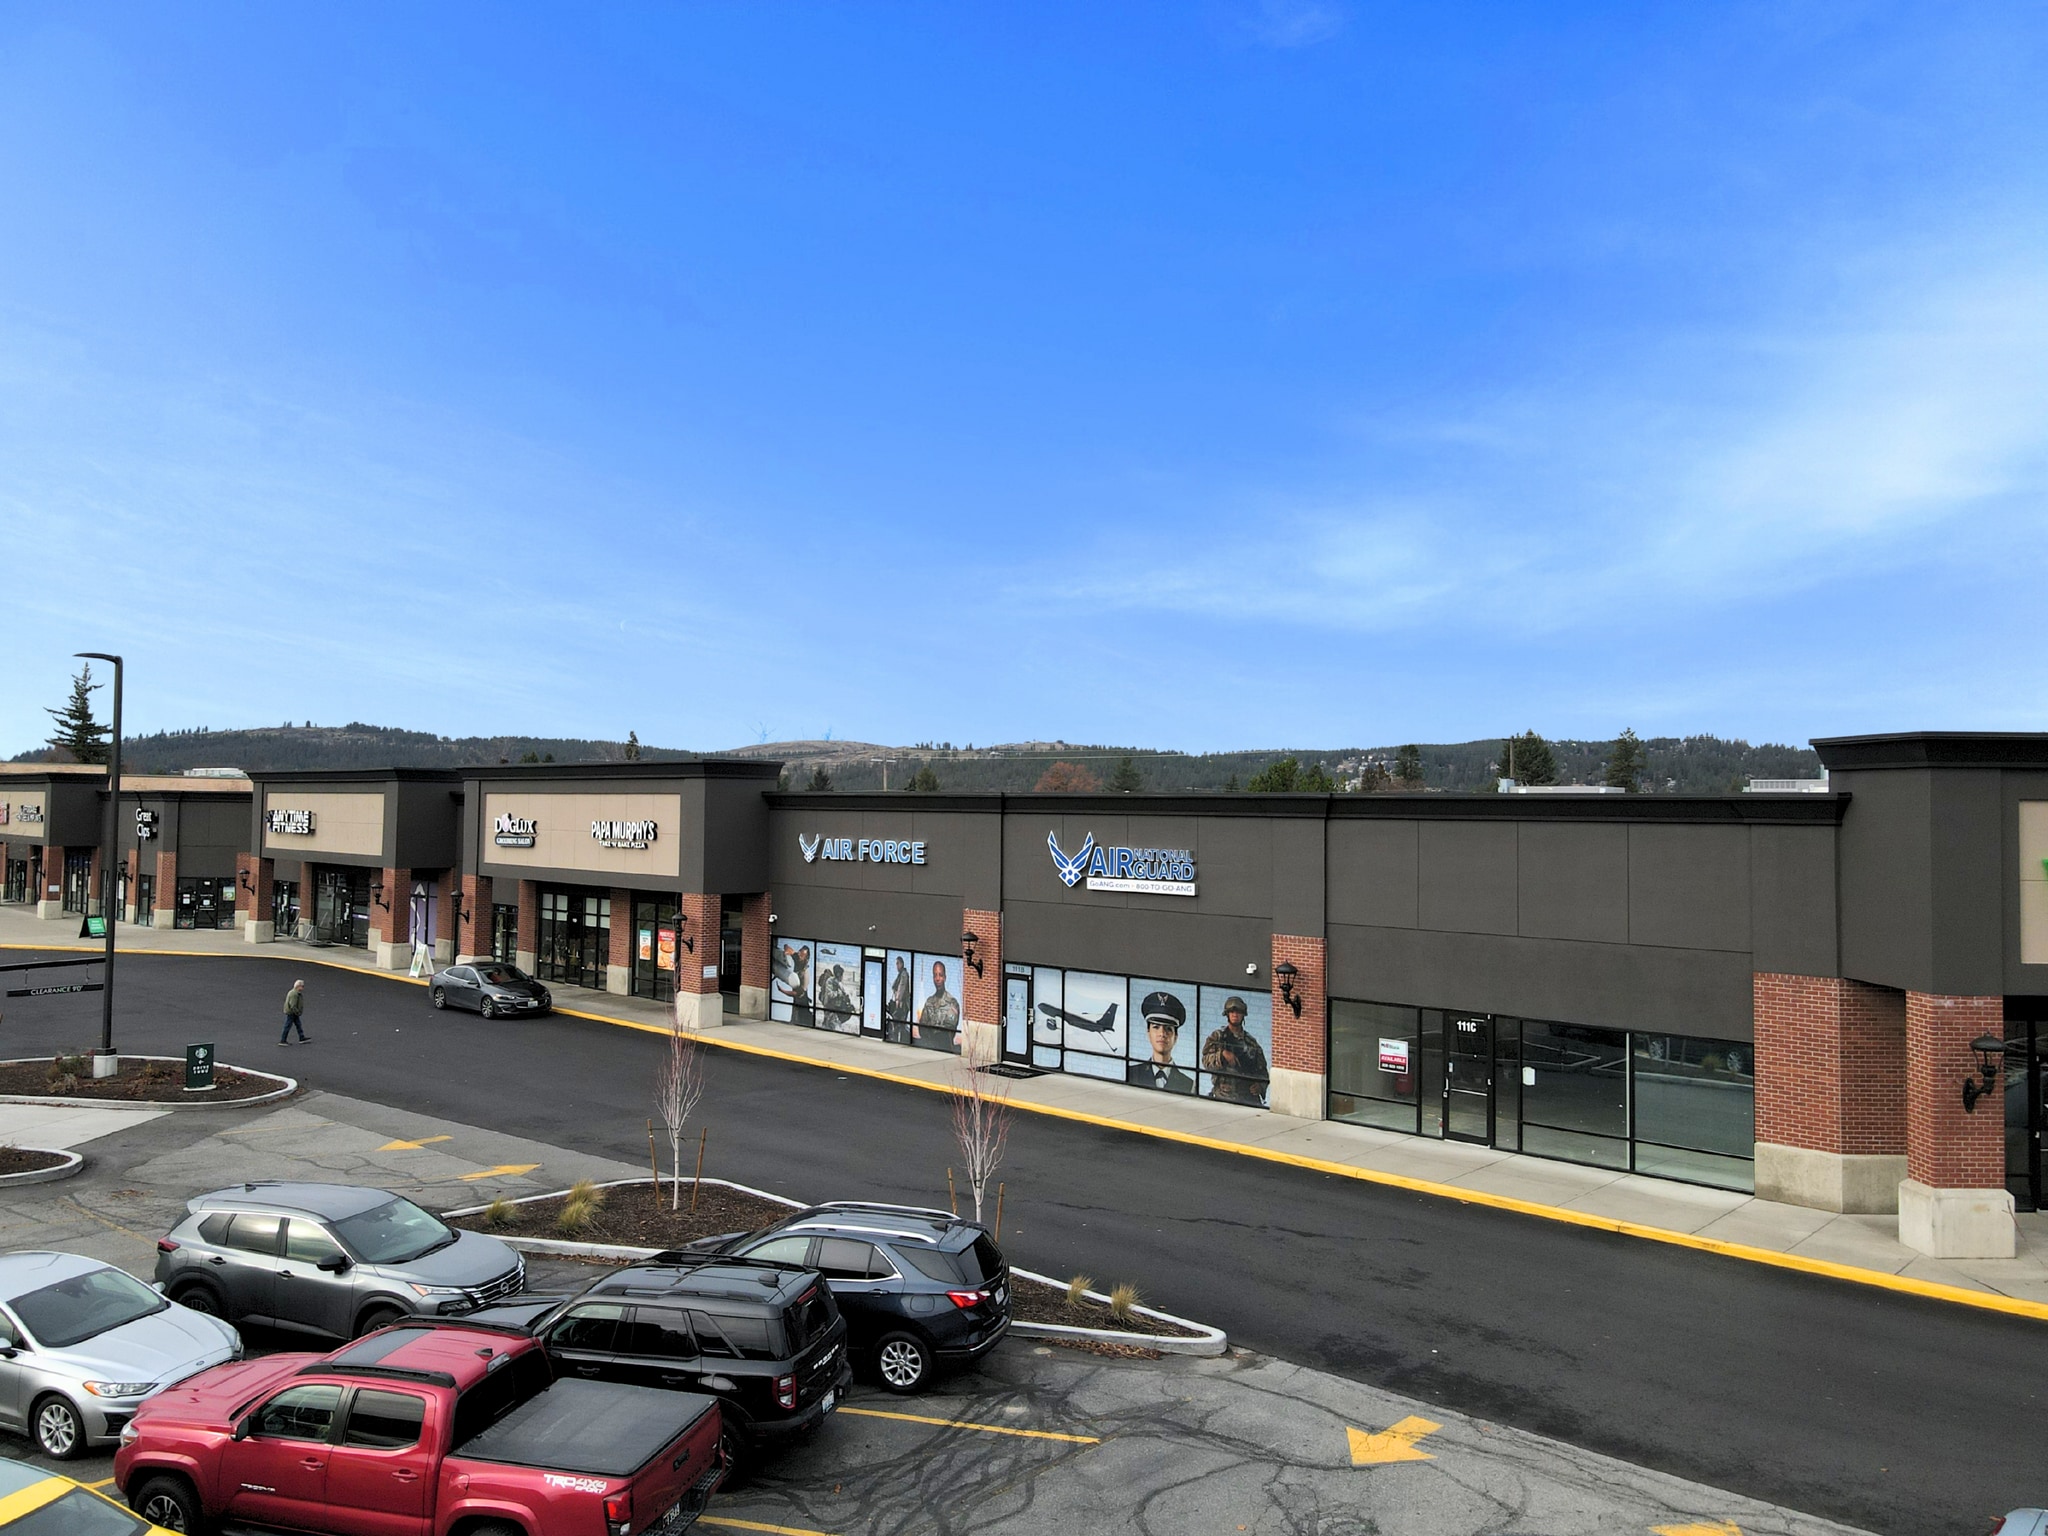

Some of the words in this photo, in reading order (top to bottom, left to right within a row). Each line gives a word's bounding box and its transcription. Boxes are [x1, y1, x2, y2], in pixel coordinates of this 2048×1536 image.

[136, 807, 152, 821] Great
[272, 810, 309, 822] ANYTIME
[137, 823, 150, 840] Clips
[272, 822, 309, 834] FITNESS
[591, 820, 611, 840] PAPA
[612, 820, 656, 841] MURPHY'S
[821, 838, 854, 861] AIR
[858, 839, 925, 864] FORCE
[1088, 846, 1135, 878] AIR
[1132, 848, 1194, 863] NATIONAL
[1133, 861, 1195, 881] GUARD
[1089, 880, 1131, 890] GoANG.com
[30, 987, 71, 996] CLEARANCE
[1457, 1020, 1477, 1032] 111C
[1381, 1055, 1406, 1063] AVAILABLE
[543, 1473, 577, 1489] TRD
